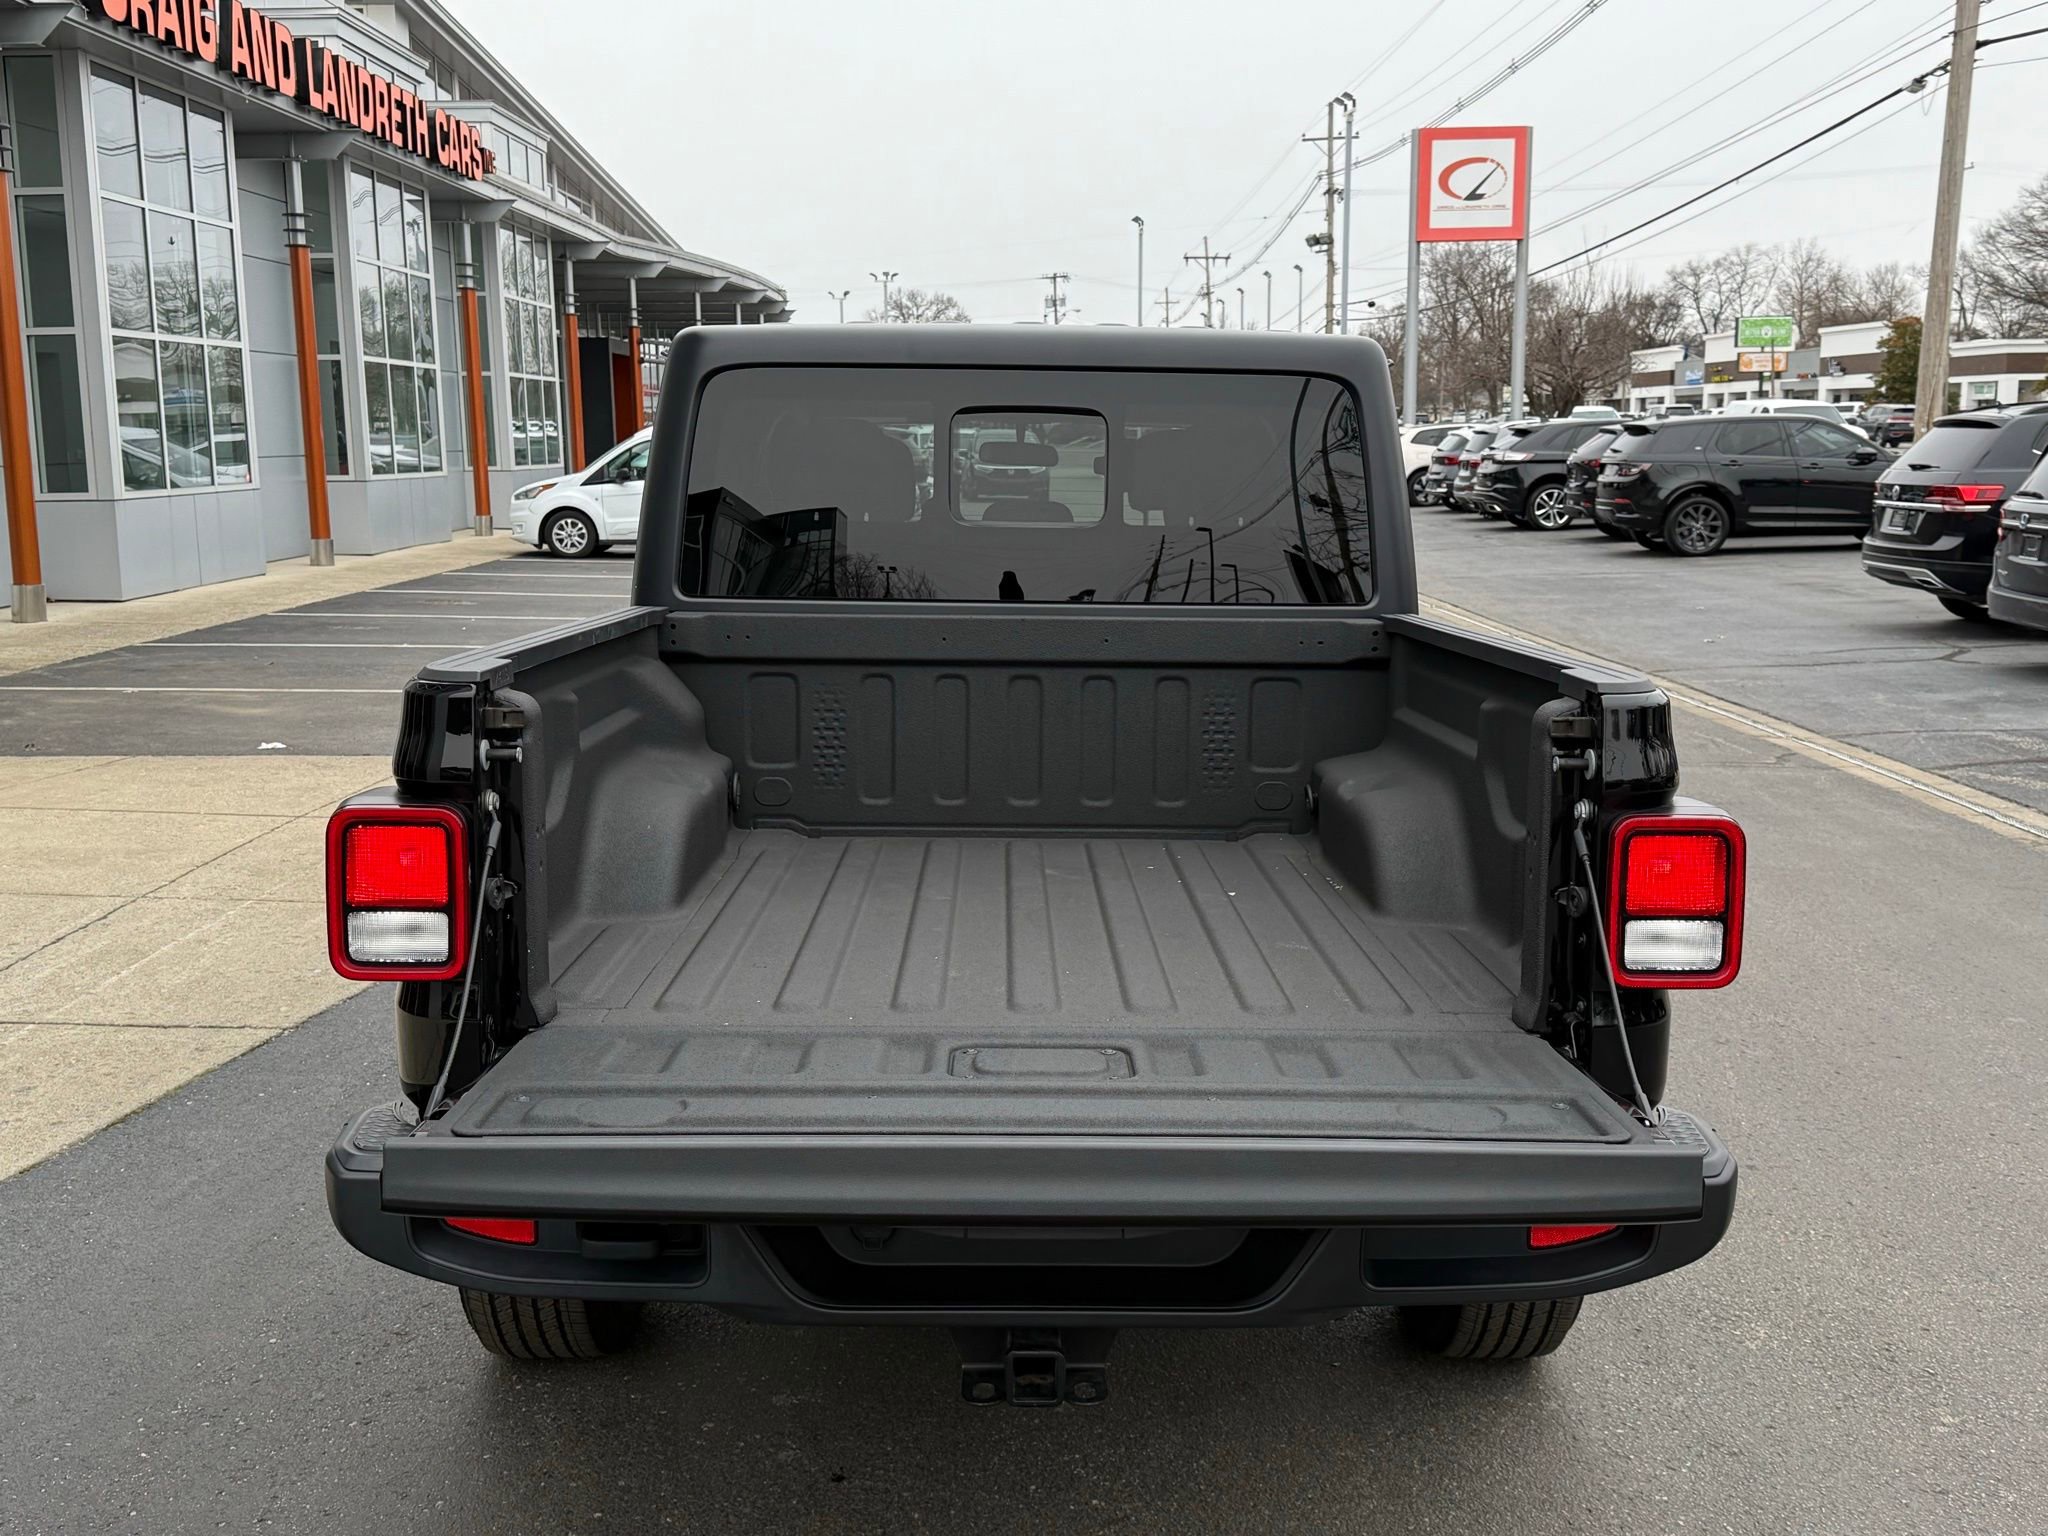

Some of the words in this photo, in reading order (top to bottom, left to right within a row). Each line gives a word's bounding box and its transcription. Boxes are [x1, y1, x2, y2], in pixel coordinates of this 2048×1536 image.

[231, 0, 297, 97] AND
[304, 37, 430, 159] LANDRETH
[435, 108, 484, 181] CARS
